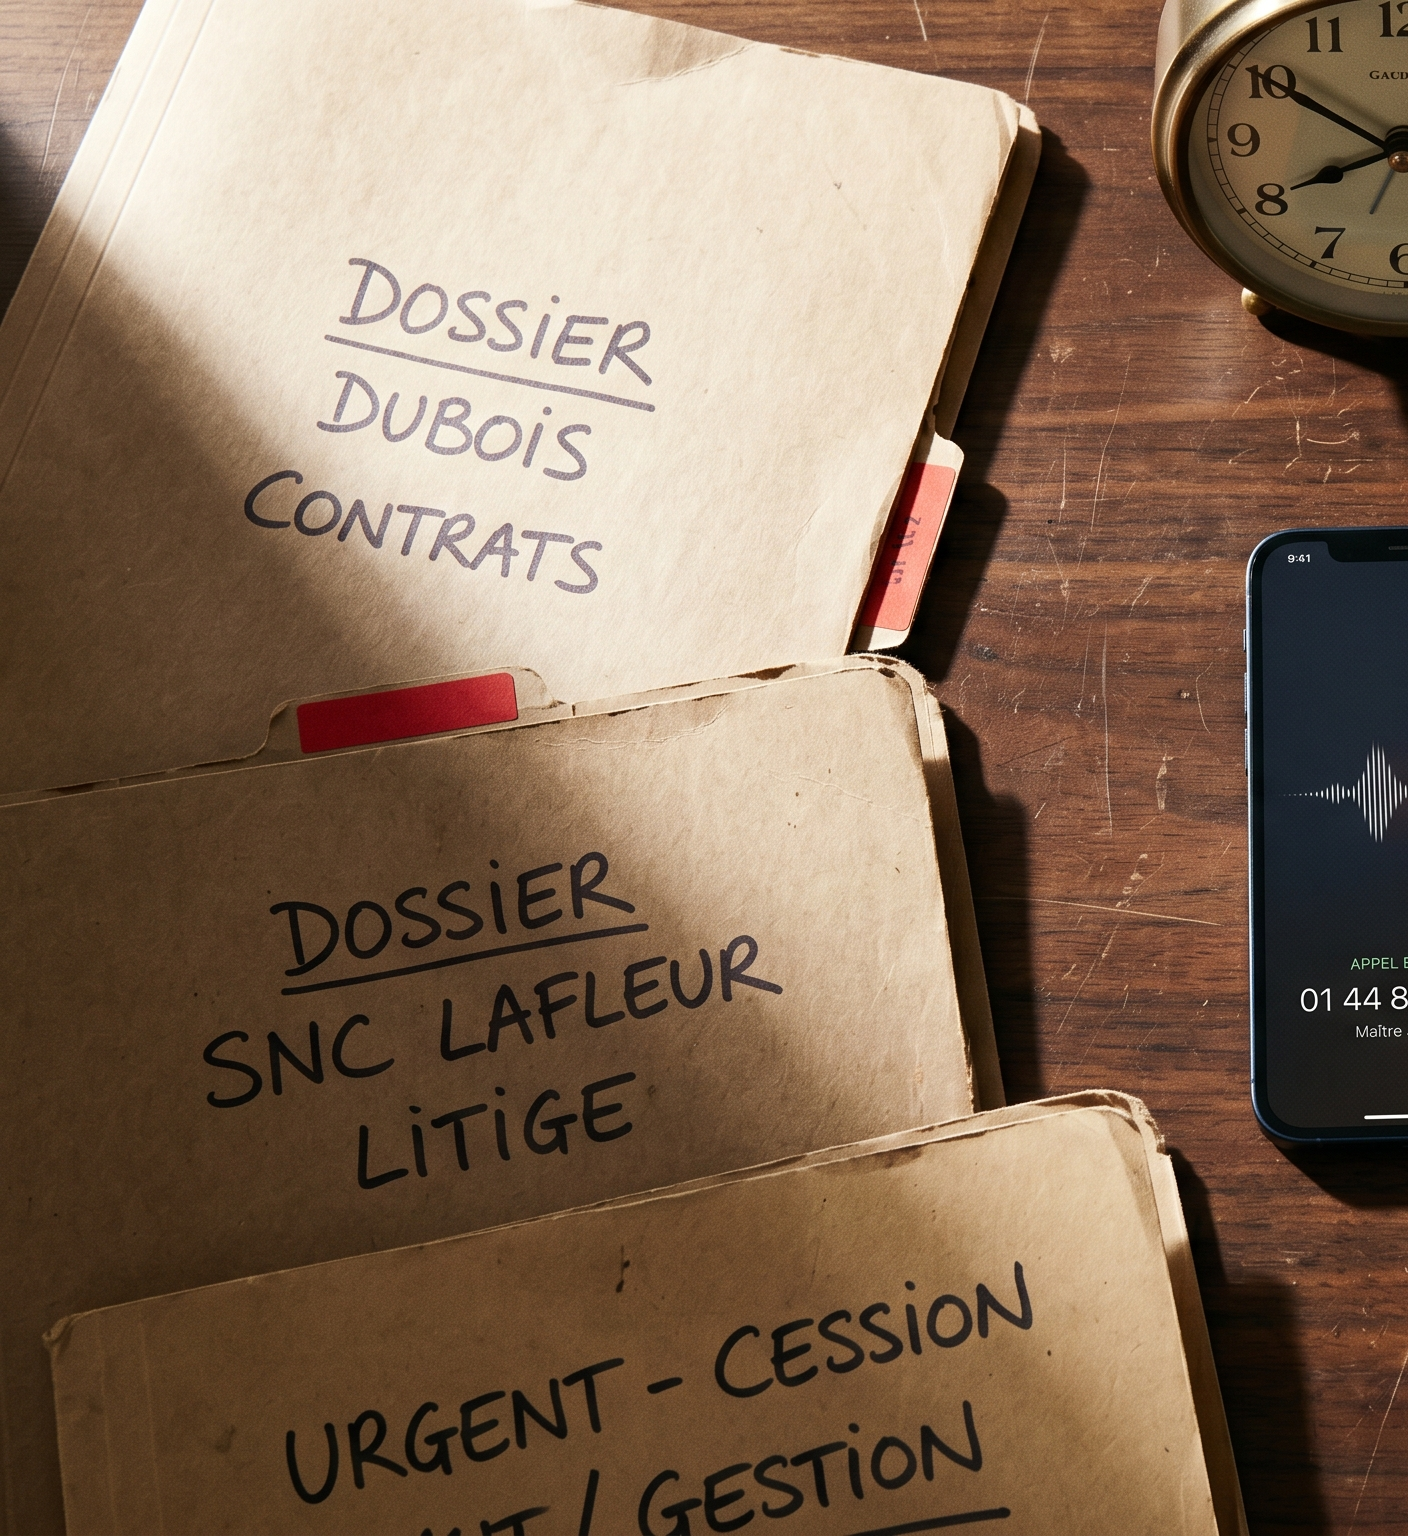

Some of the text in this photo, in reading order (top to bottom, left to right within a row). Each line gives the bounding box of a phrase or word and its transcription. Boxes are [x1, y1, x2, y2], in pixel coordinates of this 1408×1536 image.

[1306, 16, 1344, 53] 11
[1246, 64, 1296, 99] 10
[1226, 123, 1260, 157] 9
[1254, 183, 1289, 217] 8
[1314, 226, 1346, 259] 7
[243, 469, 604, 595] CONTRATS
[1350, 957, 1399, 970] APPEL
[1300, 987, 1331, 1013] 01
[1343, 986, 1382, 1011] 44
[202, 934, 784, 1109] SNC LAFLEUR
[1355, 1024, 1402, 1039] Maître
[285, 1357, 626, 1505] URGENT
